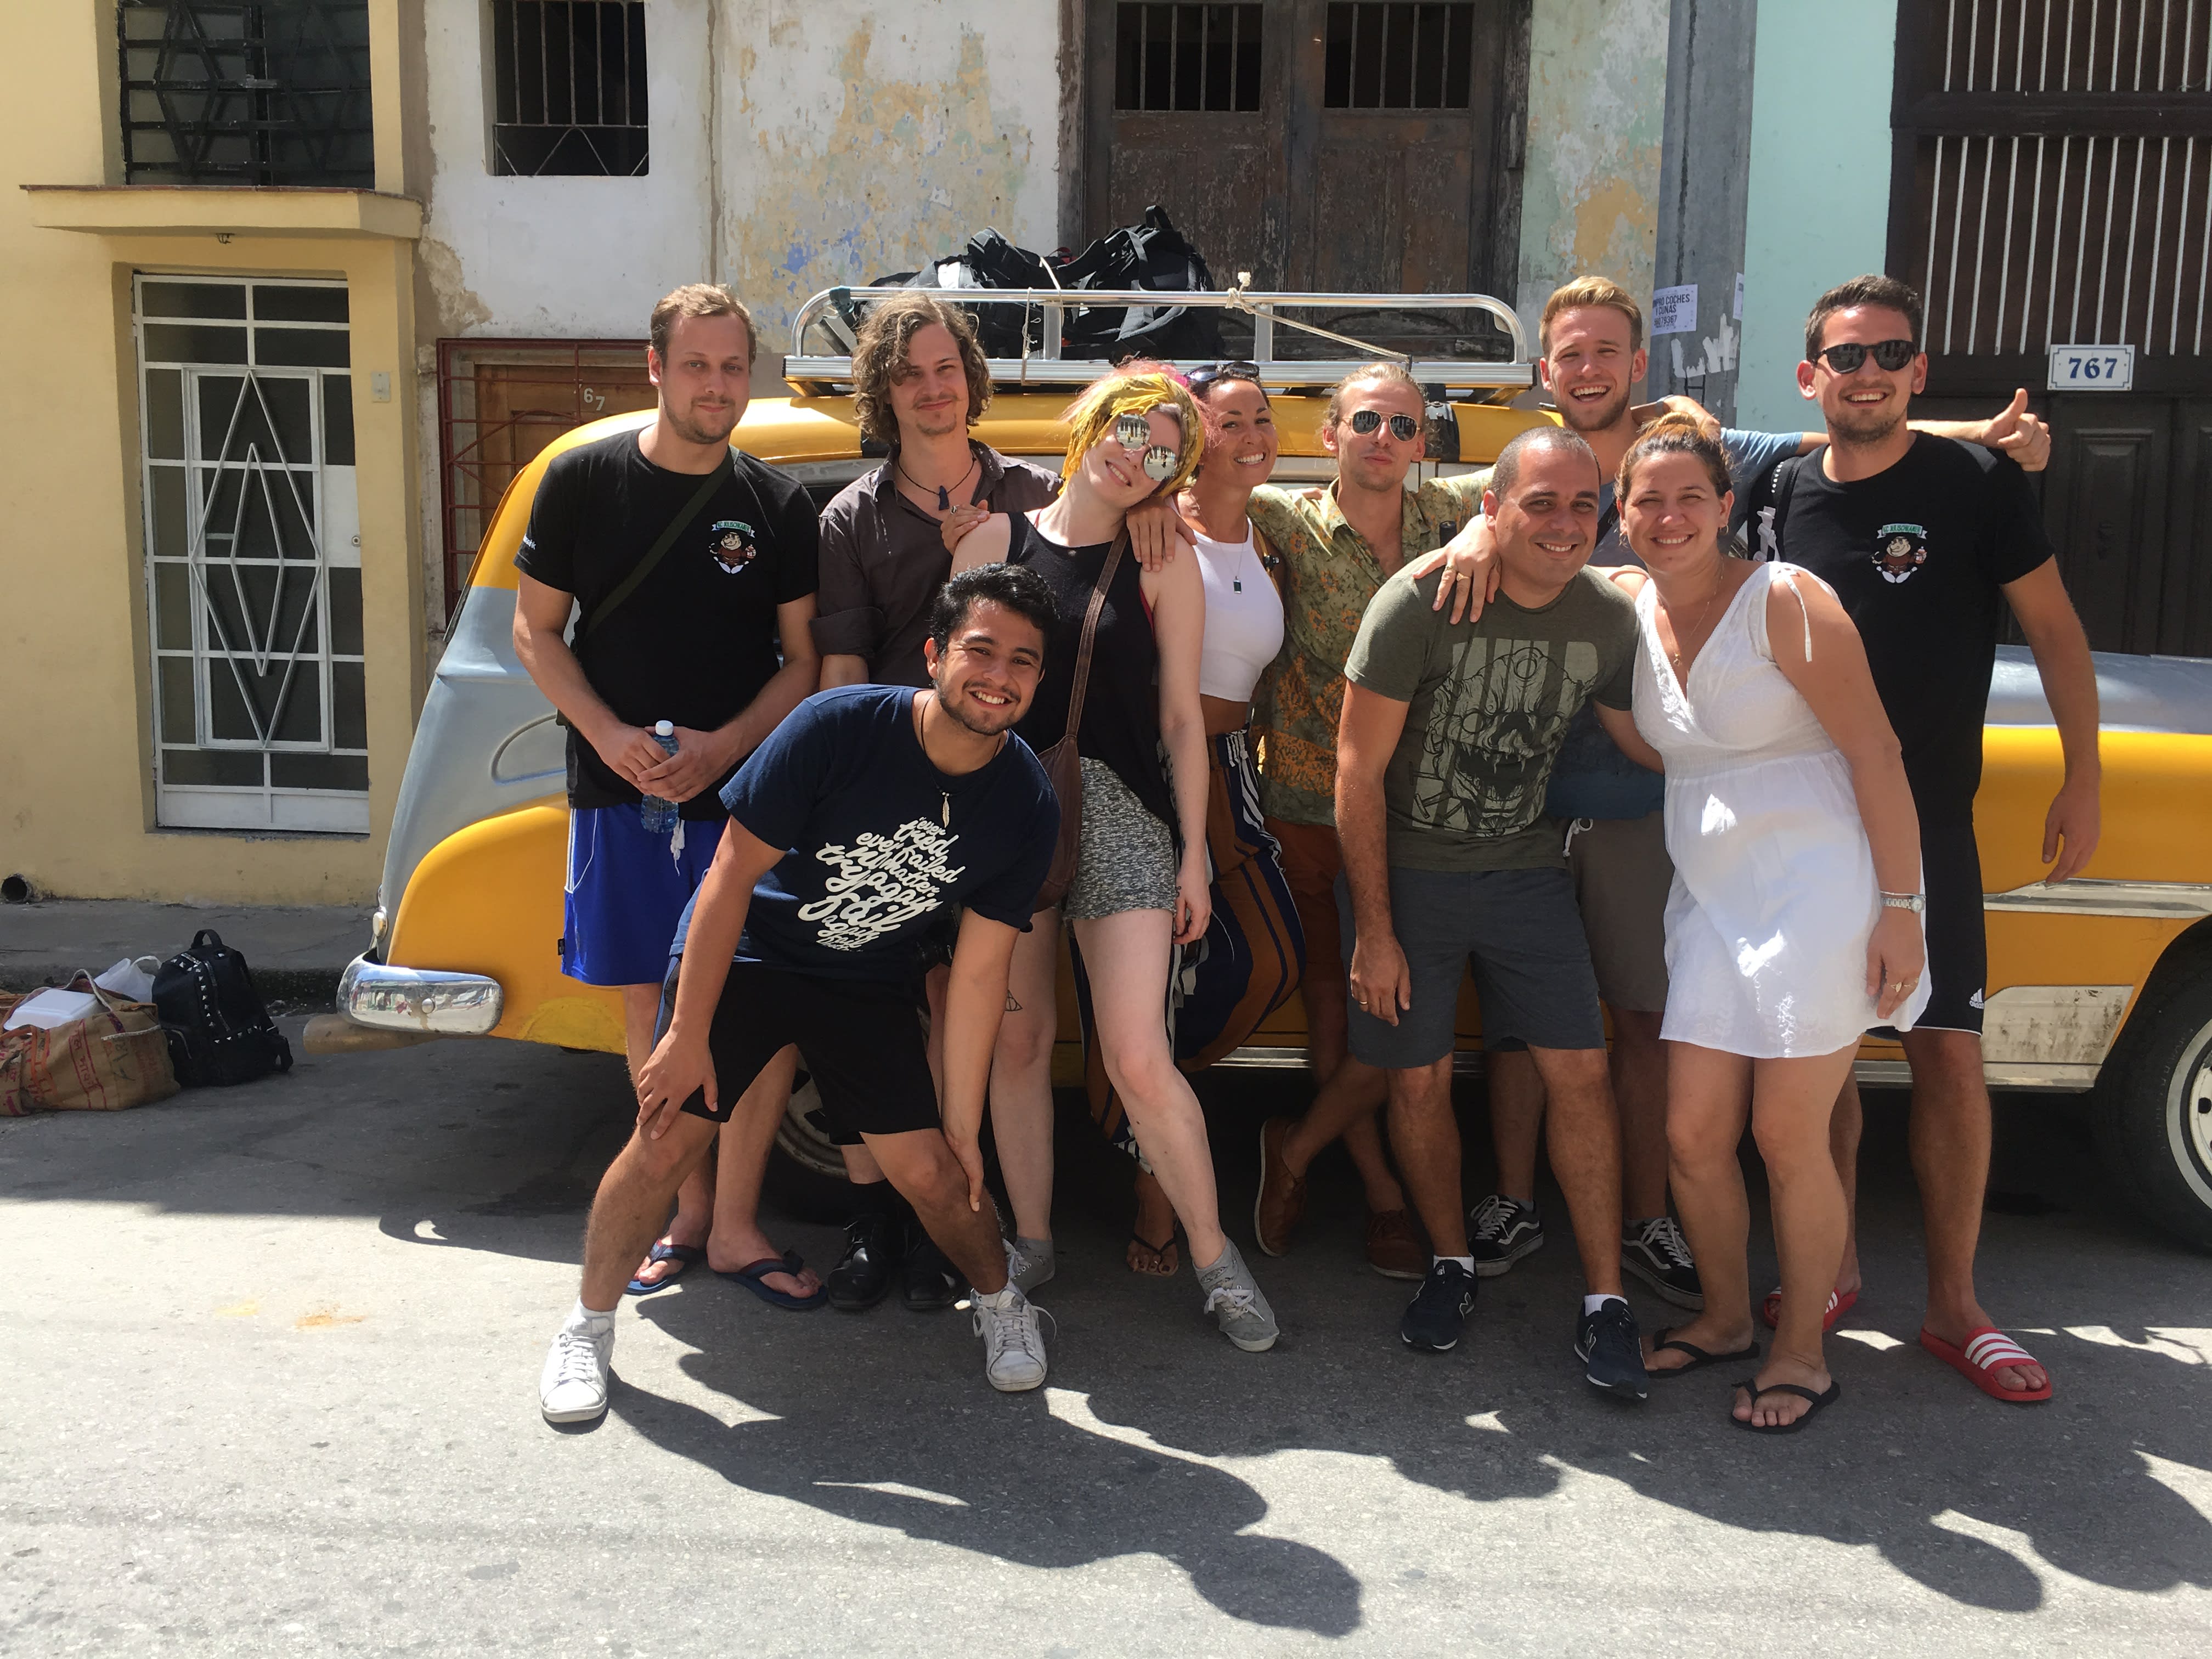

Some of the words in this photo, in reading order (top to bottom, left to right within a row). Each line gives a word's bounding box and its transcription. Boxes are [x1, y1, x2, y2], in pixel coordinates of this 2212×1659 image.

[1666, 294, 1690, 304] COCHES
[2068, 357, 2118, 379] 767
[856, 832, 905, 853] ever
[893, 820, 960, 857] tried
[816, 842, 871, 893] try
[798, 874, 927, 932] fail
